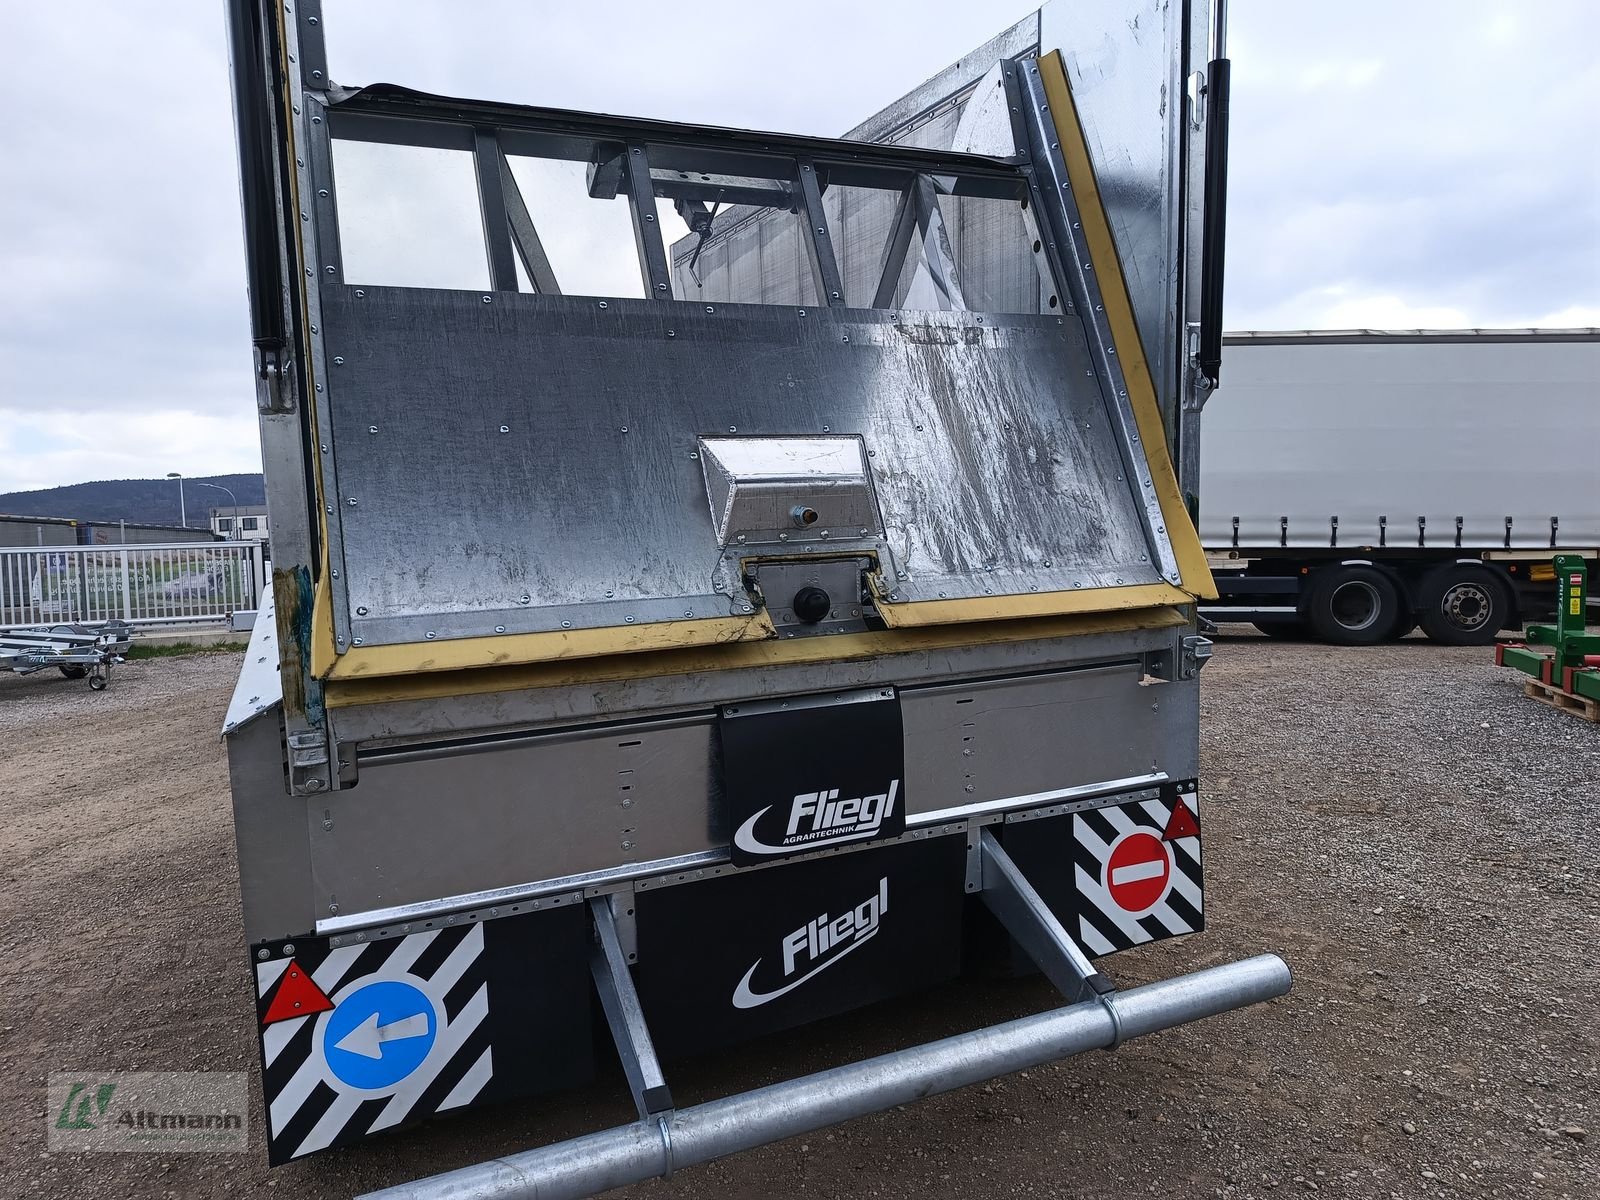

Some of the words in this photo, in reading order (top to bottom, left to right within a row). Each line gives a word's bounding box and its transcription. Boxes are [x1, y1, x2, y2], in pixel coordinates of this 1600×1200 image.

[782, 825, 856, 845] AGRARTECHNIK
[786, 779, 899, 836] Fliegl
[782, 876, 888, 977] Fliegl
